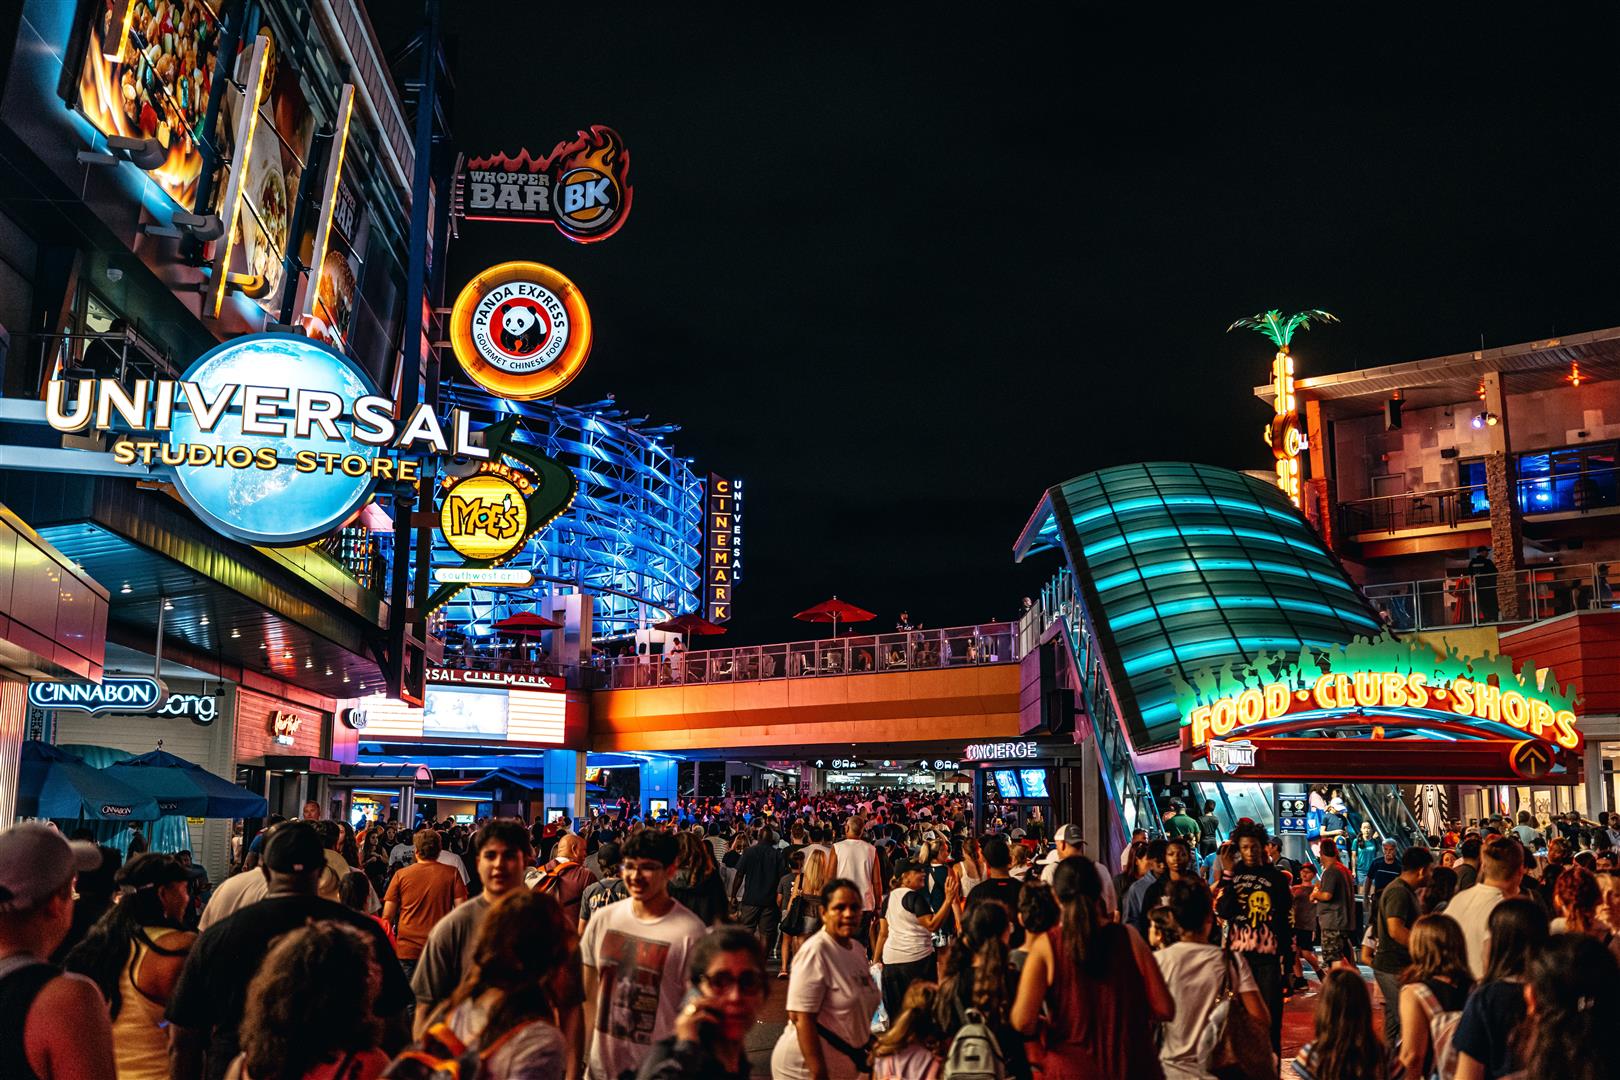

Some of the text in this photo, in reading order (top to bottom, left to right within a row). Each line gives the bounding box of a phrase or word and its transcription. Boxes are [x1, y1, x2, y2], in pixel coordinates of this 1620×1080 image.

[470, 171, 550, 187] WHOPPER
[470, 182, 550, 211] BAR
[564, 177, 611, 214] BK
[475, 284, 565, 328] PANDA EXPRESS
[476, 333, 563, 369] GOURMET CHINESE FOOD
[46, 378, 491, 458] UNIVERSAL
[113, 440, 420, 482] STUDIOS STORE
[511, 470, 530, 489] TO
[732, 480, 742, 580] UNIVERSAL
[715, 480, 729, 619] CINEMARK
[35, 682, 151, 704] CINNABON
[463, 671, 550, 688] CINEMARK
[1192, 671, 1580, 749] FOOD CLUBS SHOPS
[966, 741, 1038, 760] CONCIERGE
